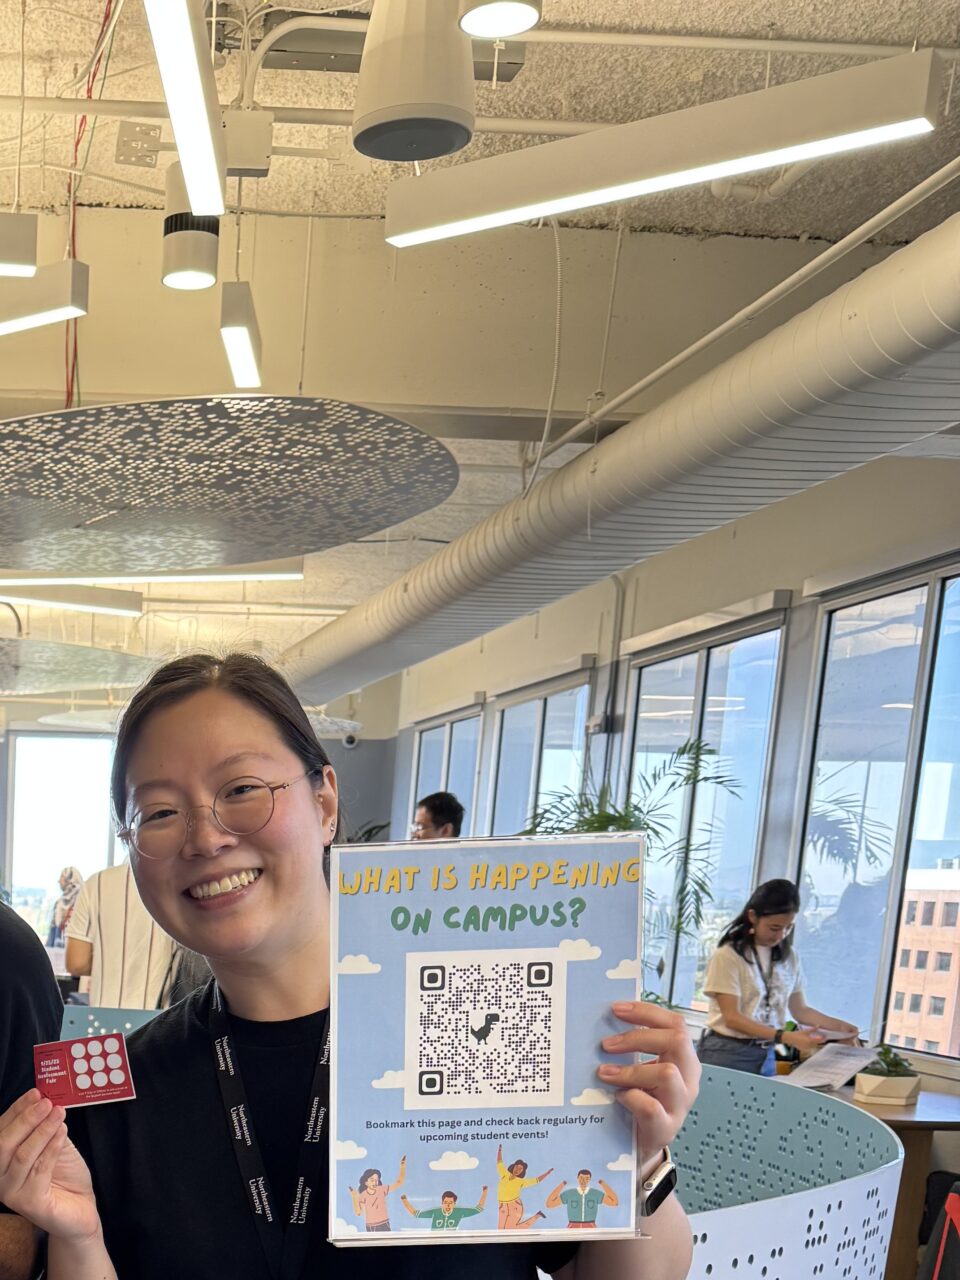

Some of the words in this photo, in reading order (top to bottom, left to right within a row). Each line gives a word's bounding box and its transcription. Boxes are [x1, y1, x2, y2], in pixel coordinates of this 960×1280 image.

[339, 867, 420, 895] WHAT
[432, 865, 456, 891] IS
[469, 857, 640, 891] HAPPENING
[391, 906, 432, 935] ON
[443, 897, 587, 933] CAMPUS?
[214, 1038, 225, 1071] University
[222, 1035, 235, 1076] Northeastern
[230, 1106, 242, 1140] University
[238, 1104, 252, 1146] Northeastern
[304, 1096, 319, 1142] Northeastern
[312, 1106, 326, 1143] University
[365, 1118, 415, 1130] Bookmark
[417, 1117, 435, 1129] this
[438, 1118, 462, 1131] page
[464, 1116, 483, 1127] and
[485, 1115, 514, 1127] check
[516, 1115, 540, 1126] back
[542, 1114, 587, 1129] regularly
[589, 1114, 605, 1125] for
[419, 1131, 467, 1144] upcoming
[470, 1130, 510, 1141] student
[512, 1129, 549, 1140] events!
[248, 1178, 262, 1215] University
[256, 1176, 273, 1222] Northeastern
[290, 1176, 304, 1224] Northeastern
[298, 1186, 312, 1224] University
